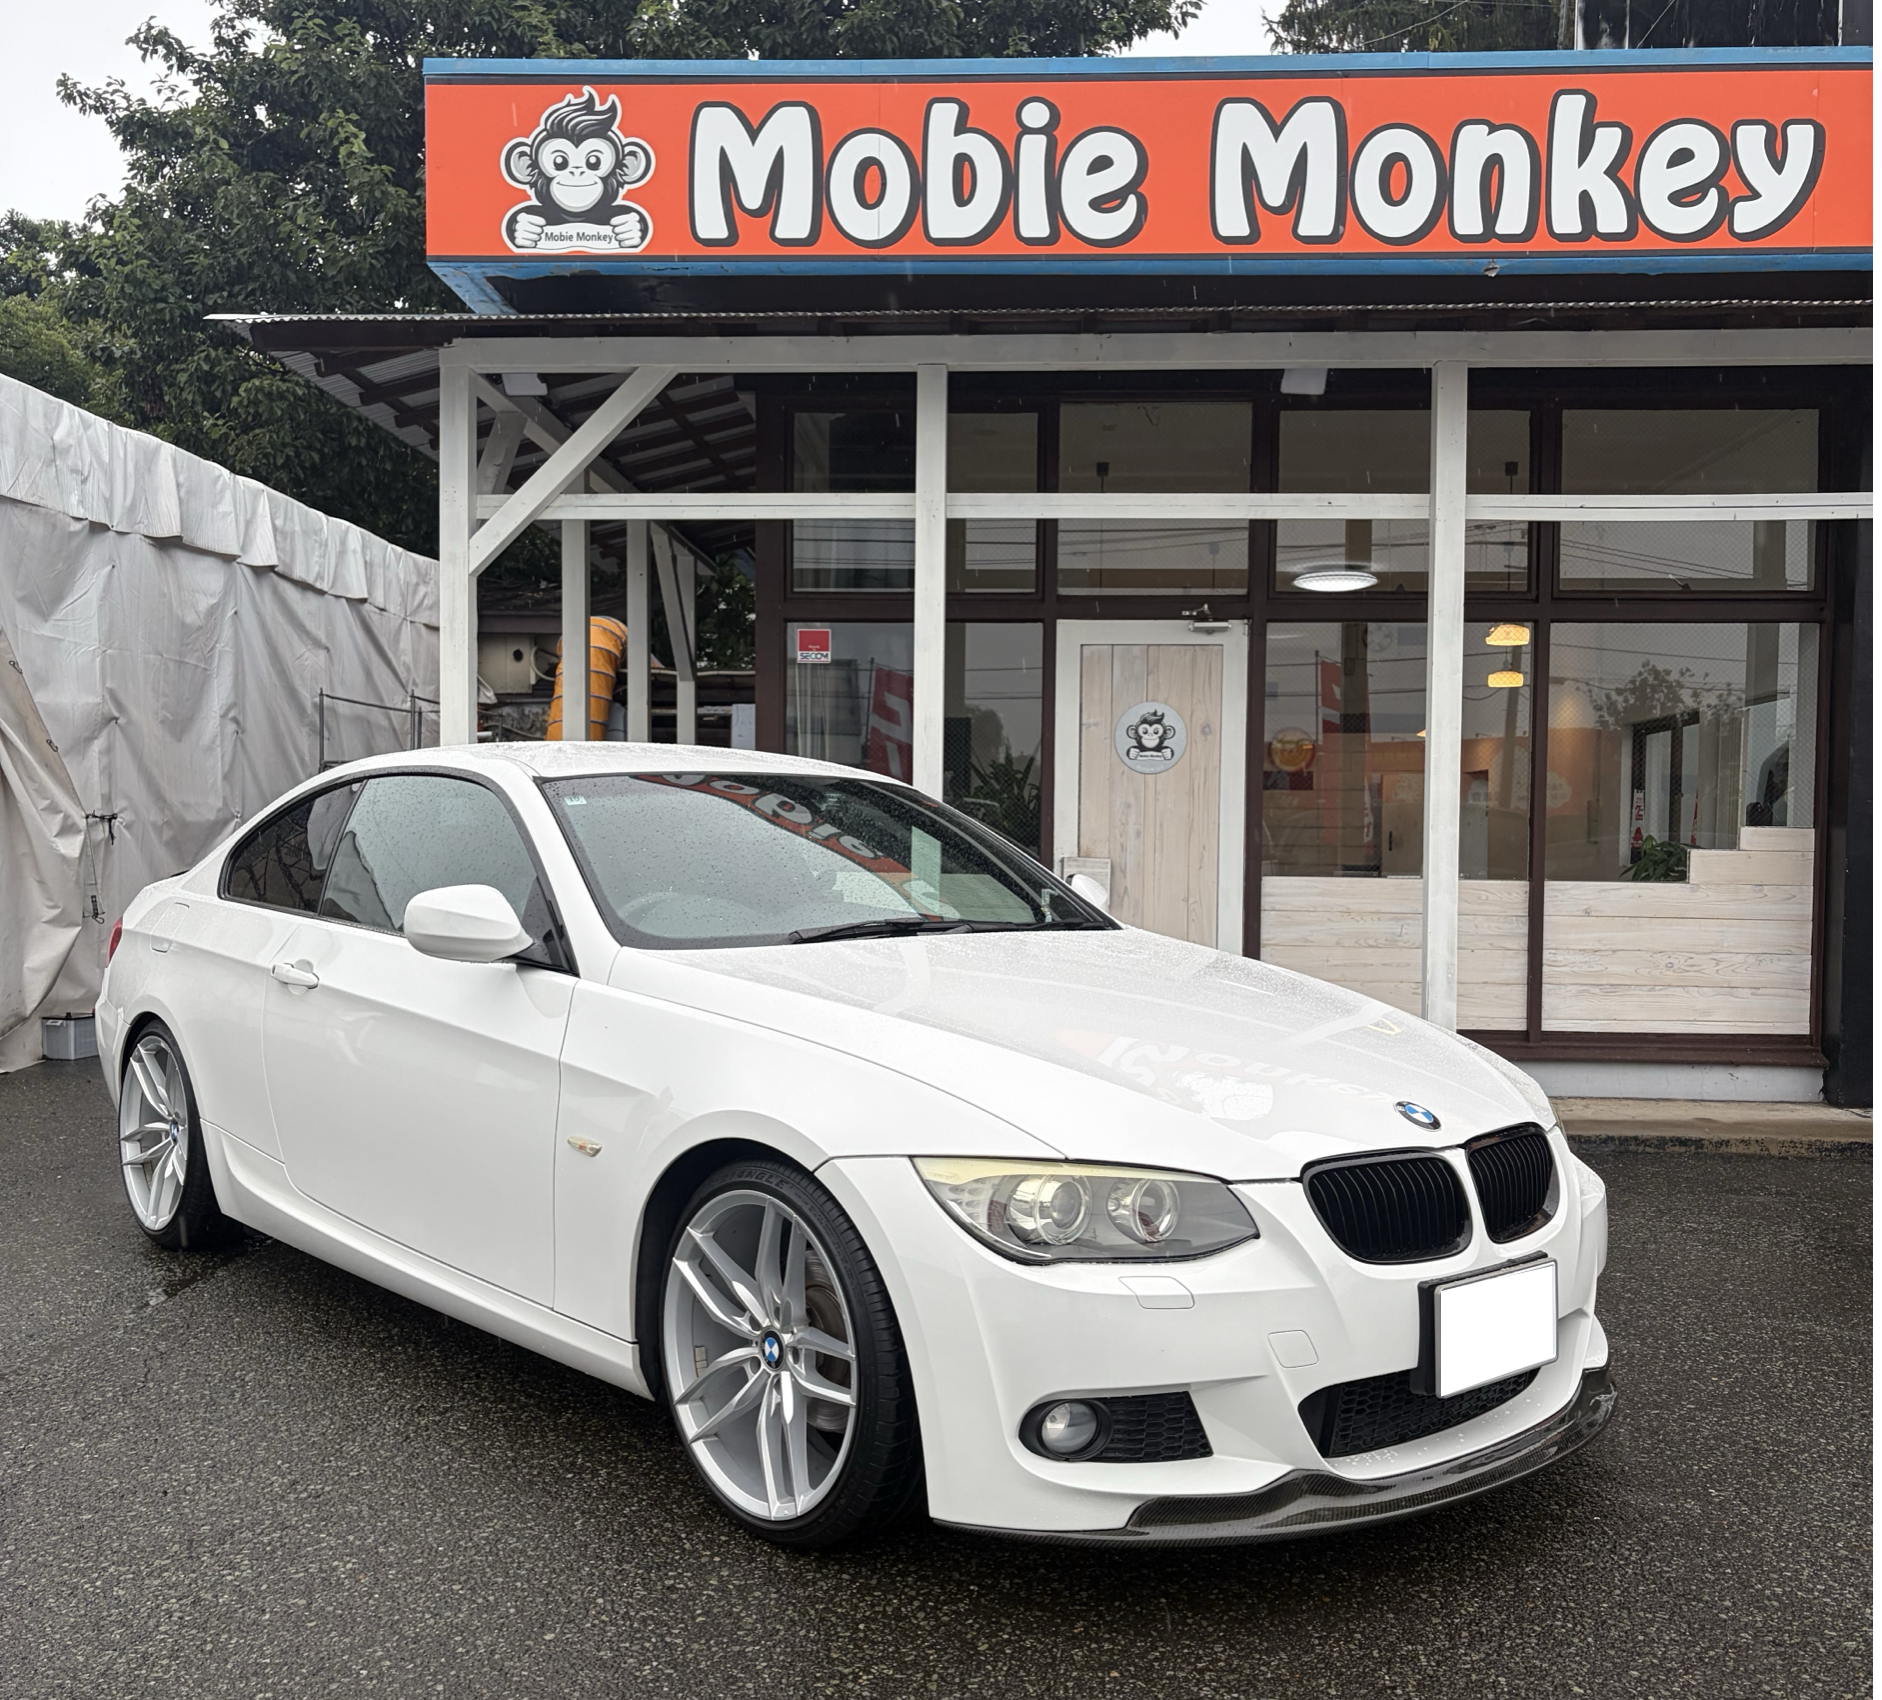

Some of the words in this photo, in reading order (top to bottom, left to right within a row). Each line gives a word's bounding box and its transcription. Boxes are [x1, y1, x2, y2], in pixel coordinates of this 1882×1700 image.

[692, 97, 1145, 246] Mobie
[1211, 90, 1824, 244] Monkey
[544, 231, 574, 242] Mobie
[576, 231, 614, 244] Monkey
[799, 652, 829, 660] SECOM
